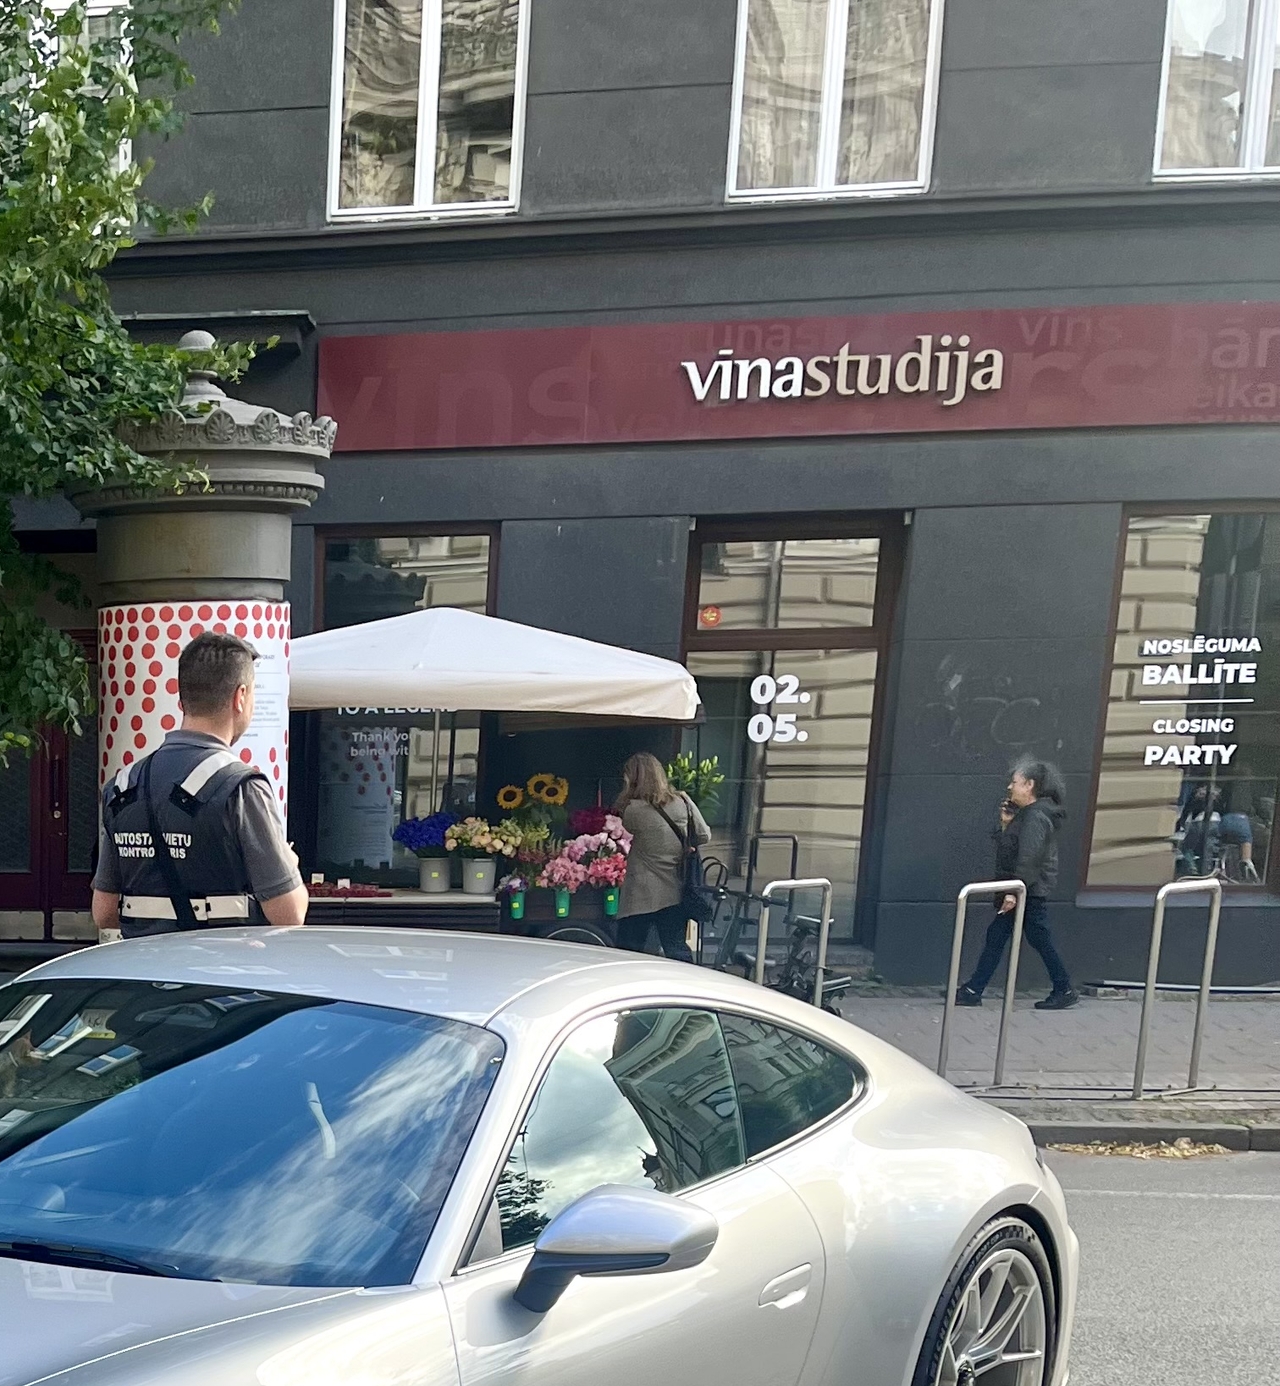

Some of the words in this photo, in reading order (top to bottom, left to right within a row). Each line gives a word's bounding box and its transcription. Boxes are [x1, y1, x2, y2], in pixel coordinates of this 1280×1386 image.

[681, 334, 1004, 406] vīnastudija
[1143, 635, 1262, 655] NOSLĒGUMA
[1142, 658, 1257, 685] BALLĪTE
[750, 674, 811, 705] 02.
[352, 732, 390, 743] Thank
[747, 713, 809, 743] 05.
[1152, 718, 1235, 734] CLOSING
[1144, 744, 1238, 766] PARTY
